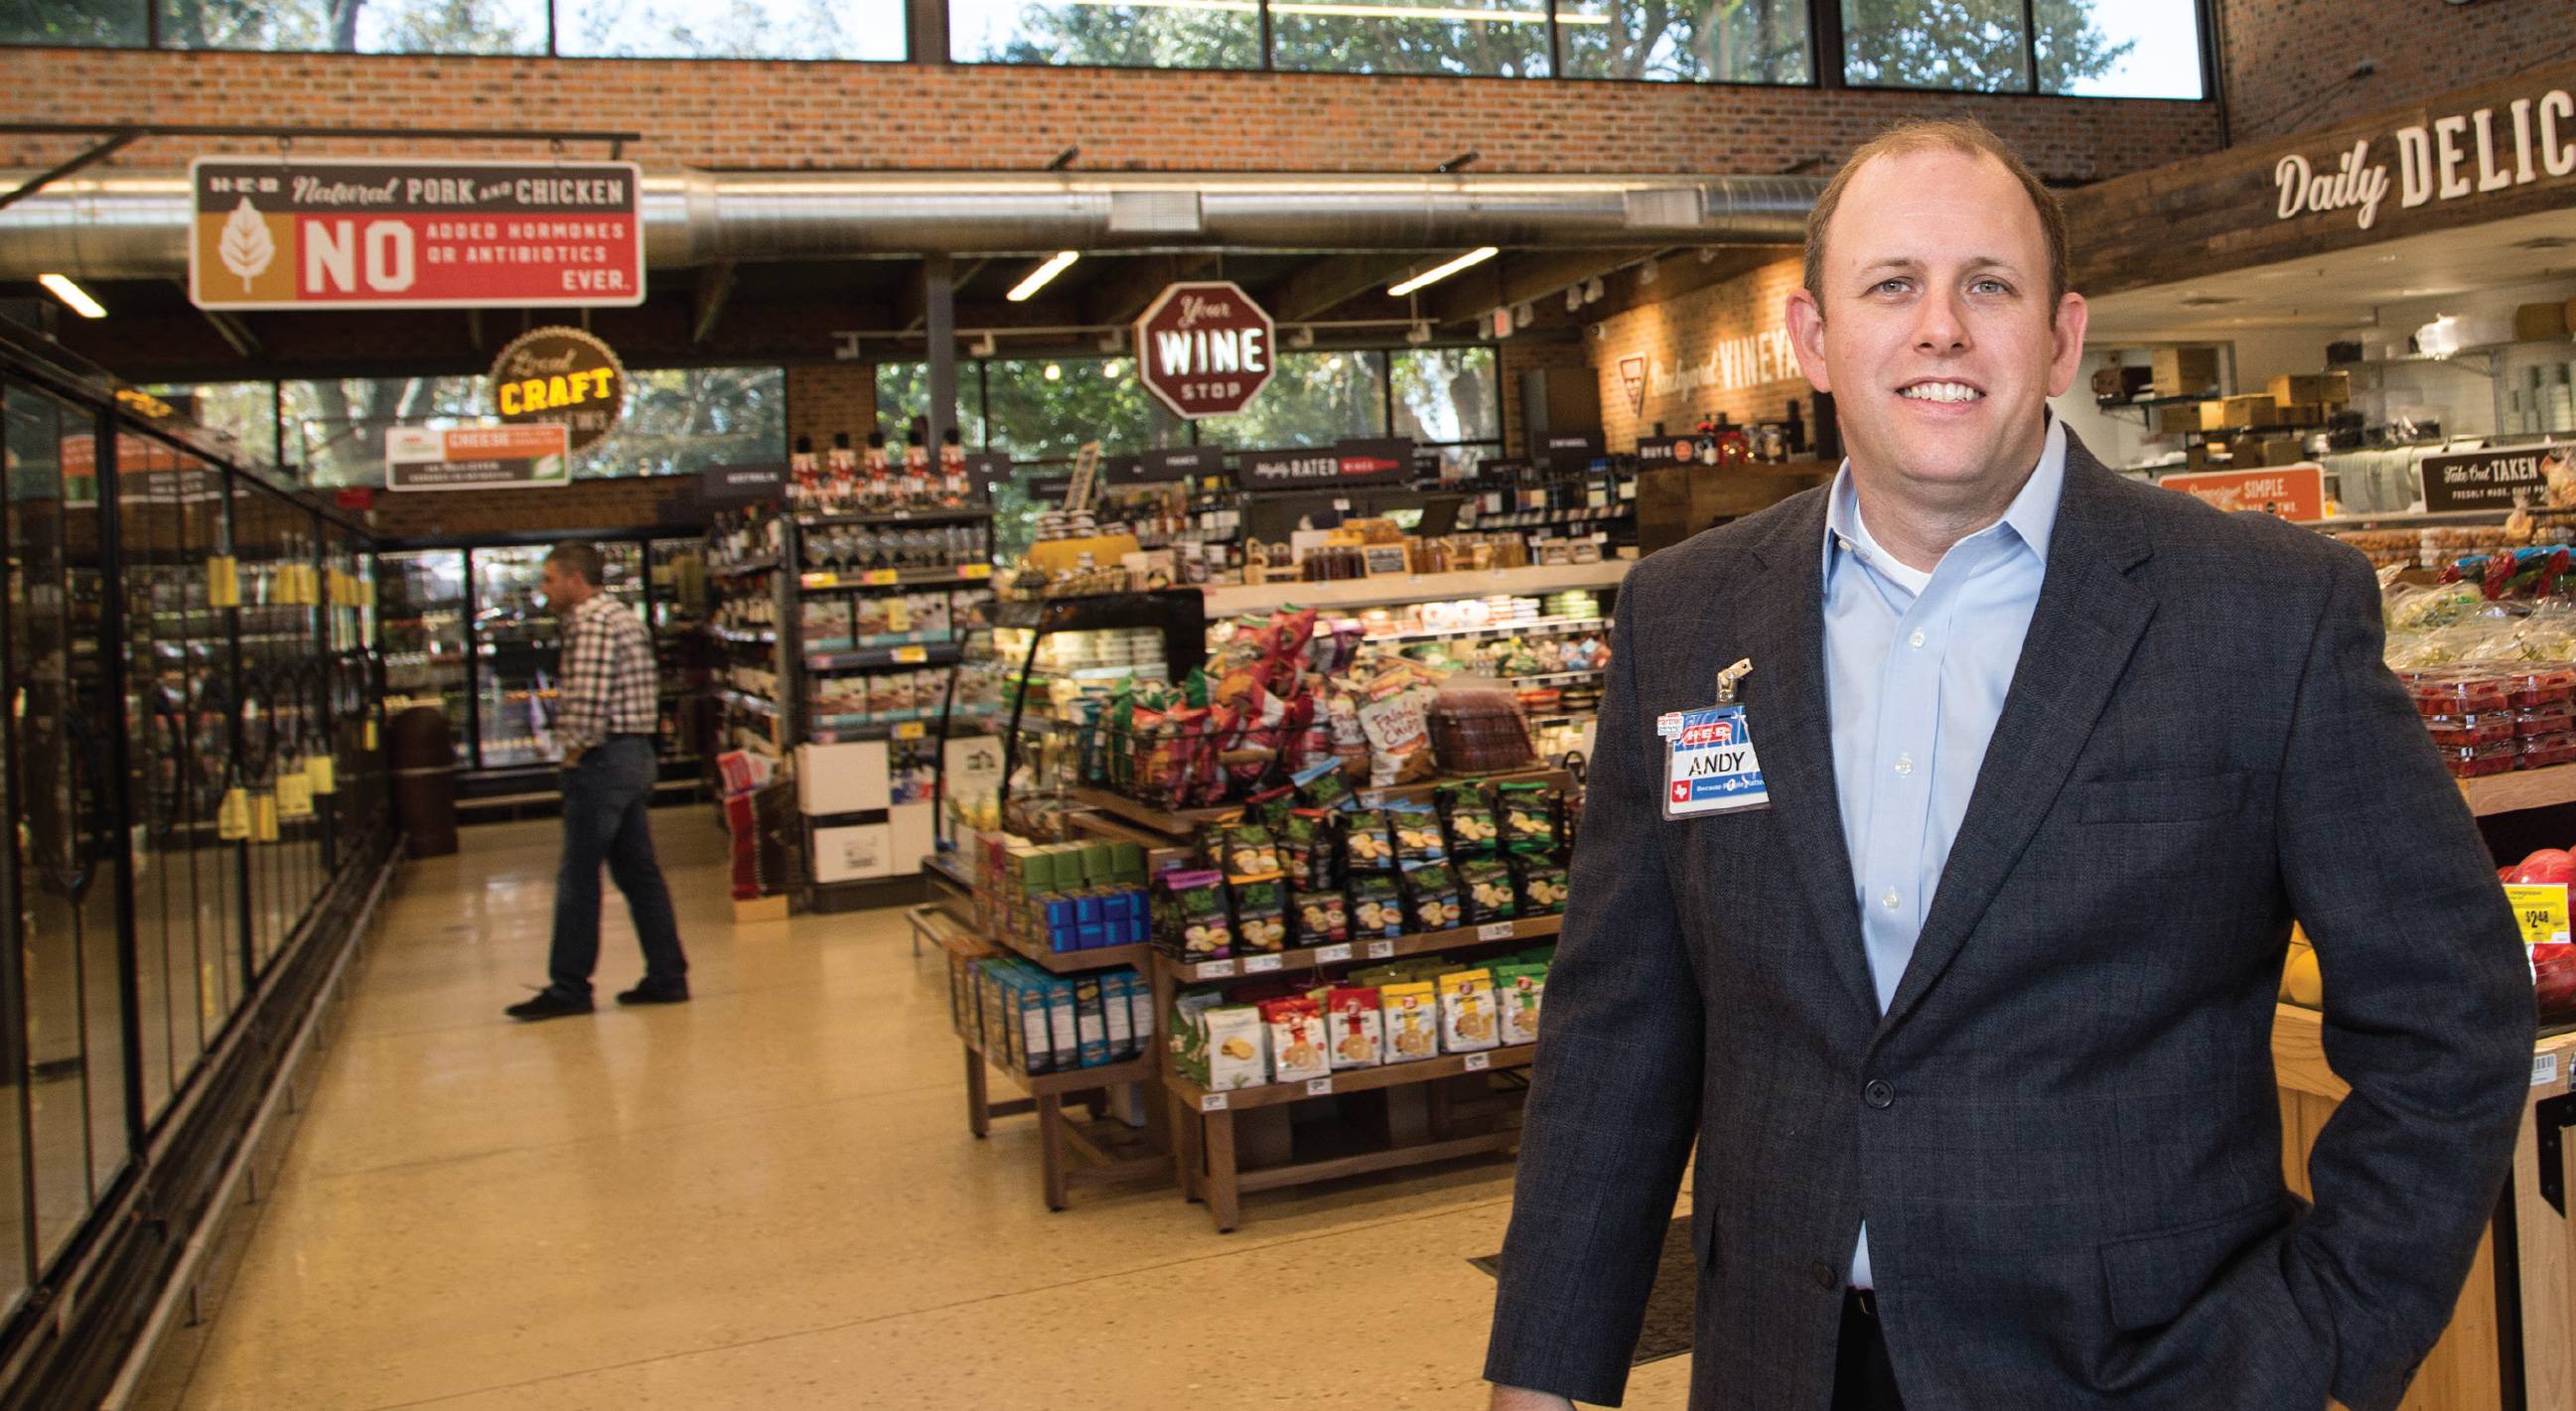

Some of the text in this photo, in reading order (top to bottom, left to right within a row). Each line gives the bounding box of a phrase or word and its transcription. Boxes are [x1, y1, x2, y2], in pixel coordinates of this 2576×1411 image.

[293, 176, 400, 206] Natural
[407, 178, 476, 205] PORK
[480, 182, 512, 201] AND
[515, 178, 624, 205] CHICKEN
[2275, 139, 2389, 229] Daily
[427, 221, 625, 240] ADDED HORMONES
[304, 219, 415, 293] NO
[427, 245, 607, 263] OR ANTIBIOTICS
[562, 269, 632, 291] EVER.
[1178, 295, 1232, 329] Your
[1155, 327, 1266, 376] WINE
[500, 366, 614, 415] CRAFT
[1181, 381, 1241, 400] STOP
[1291, 458, 1338, 478] RATED
[2444, 457, 2538, 484] Take Out TAKEN
[1688, 751, 1745, 776] ANDY
